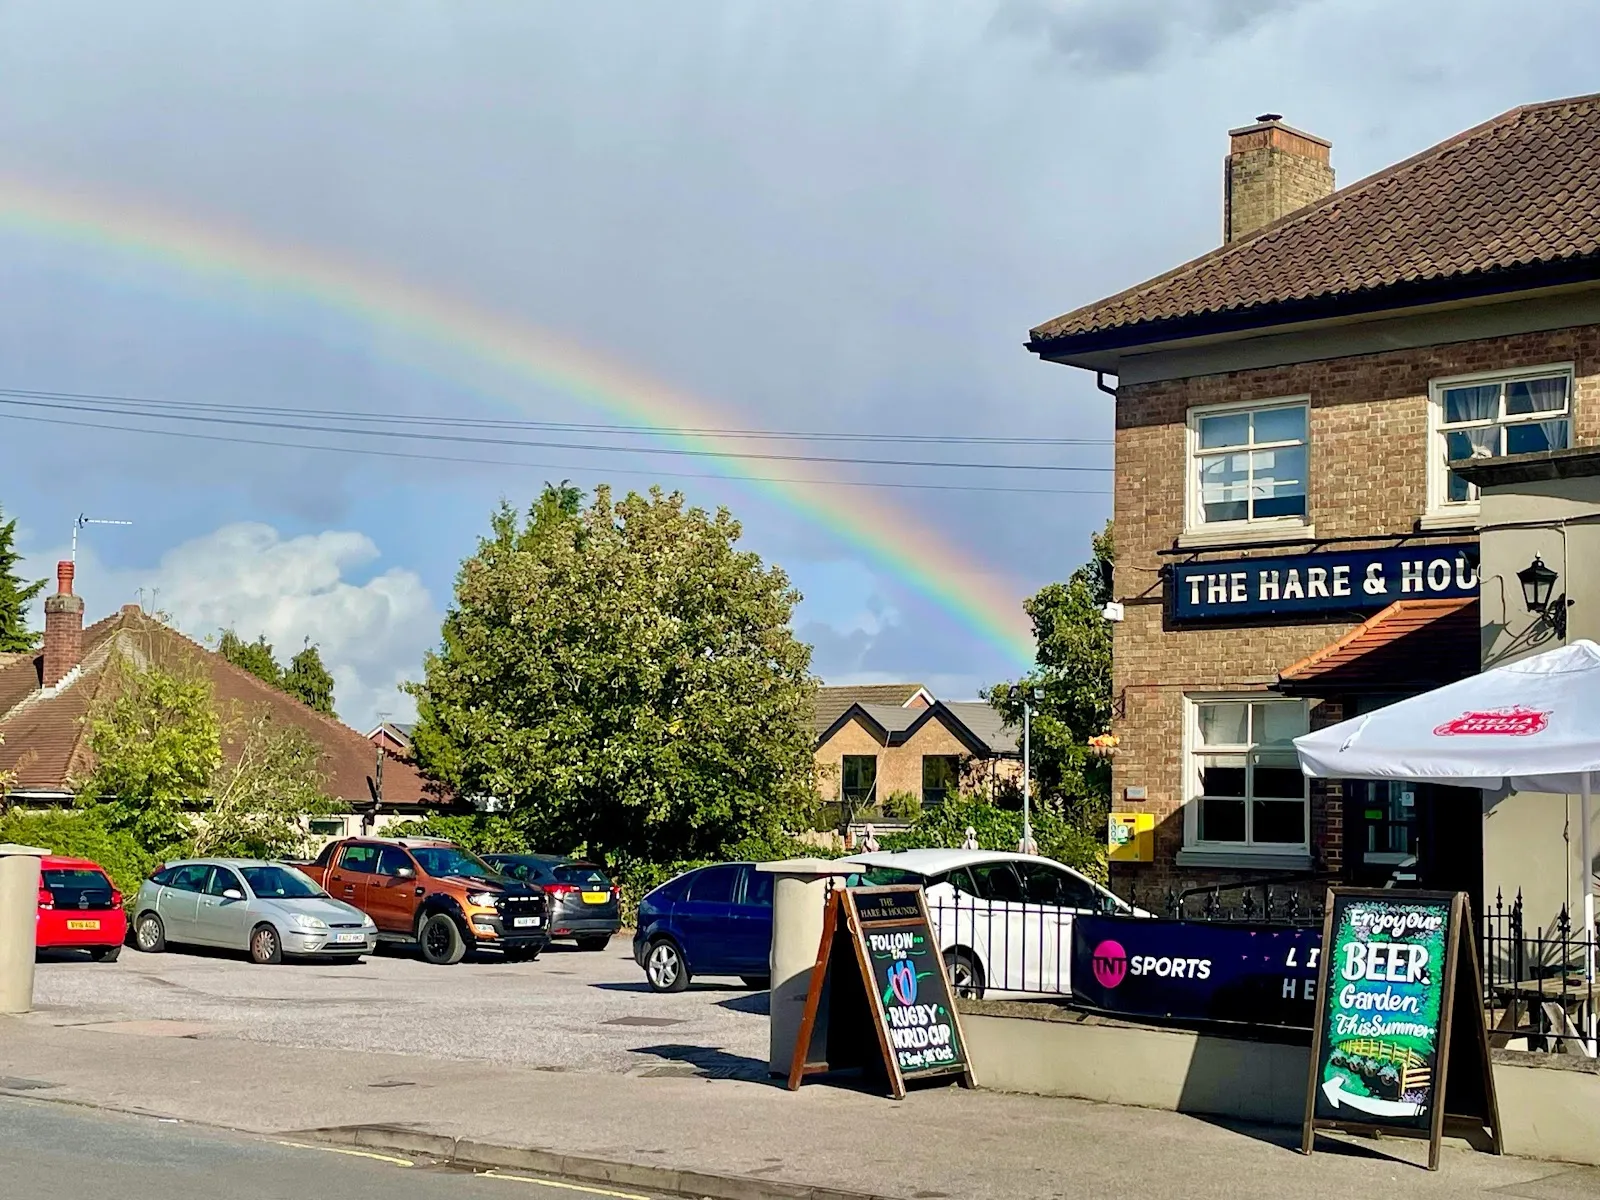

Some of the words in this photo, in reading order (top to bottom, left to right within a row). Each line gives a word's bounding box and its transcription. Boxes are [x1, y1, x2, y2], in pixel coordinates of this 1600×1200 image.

[1185, 572, 1248, 604] THE
[1259, 565, 1350, 600] HARE
[1362, 562, 1388, 595] &
[1465, 717, 1533, 725] STELLA
[860, 907, 881, 918] HARE
[888, 906, 919, 916] HOUNDS
[879, 898, 895, 907] THE
[1350, 908, 1405, 938] Enjoy
[869, 932, 914, 951] FOLLOW
[1092, 956, 1127, 976] TNT
[1130, 955, 1212, 980] SPORTS
[1339, 983, 1420, 1014] Garden
[888, 1003, 938, 1027] RUGBY
[1335, 1013, 1372, 1036] This
[1369, 1014, 1435, 1039] Summer
[890, 1027, 929, 1048] WORLD
[928, 1024, 951, 1046] CUP
